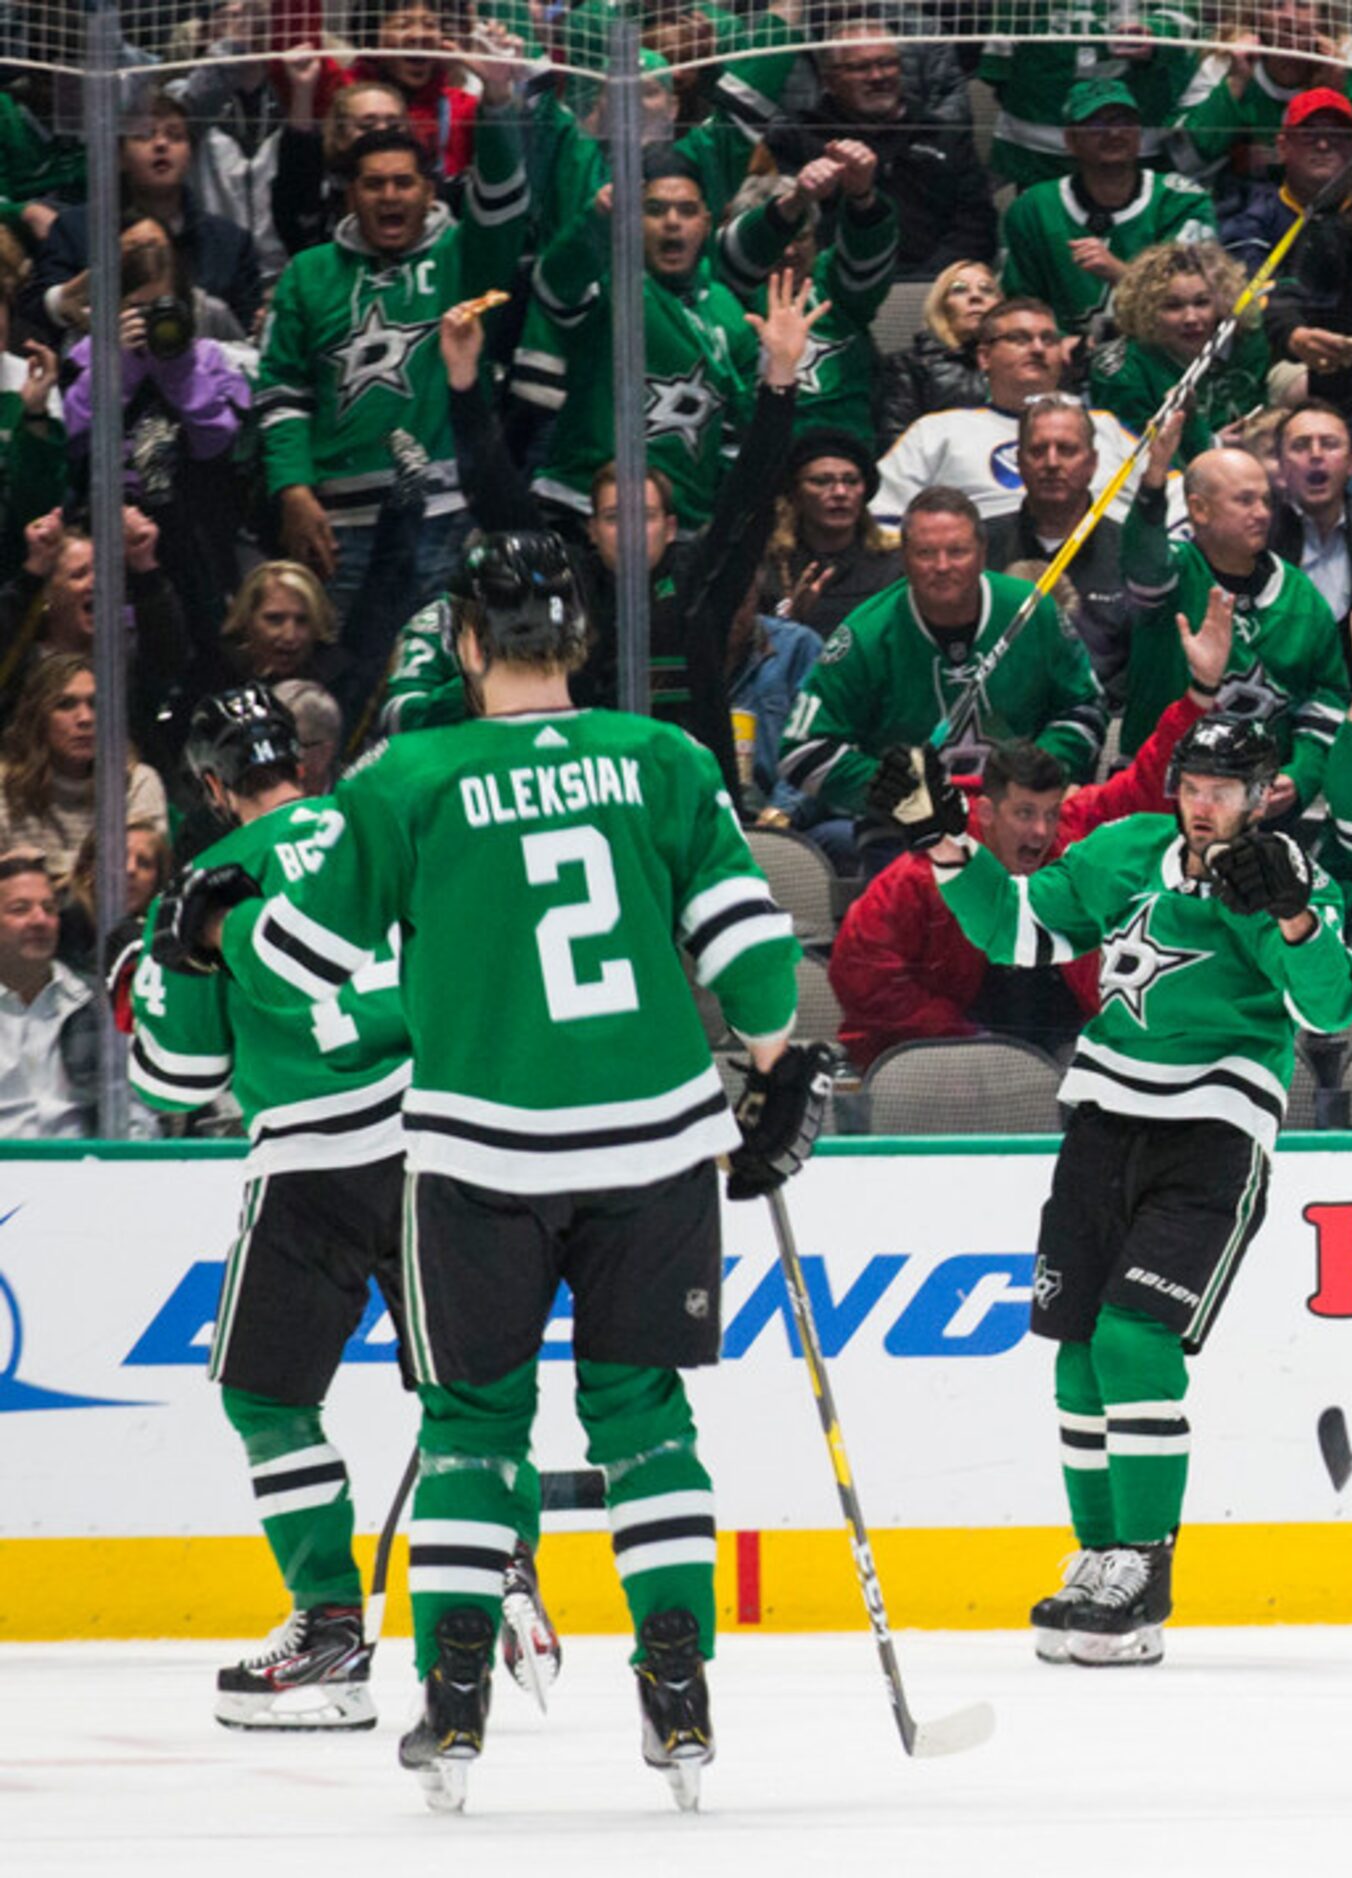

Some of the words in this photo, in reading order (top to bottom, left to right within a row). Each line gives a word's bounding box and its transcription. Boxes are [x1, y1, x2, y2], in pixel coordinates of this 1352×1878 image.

[416, 259, 437, 294] C
[459, 756, 643, 829] OLEKSIAK
[520, 824, 641, 1023] 2
[1124, 1266, 1201, 1308] BAUER
